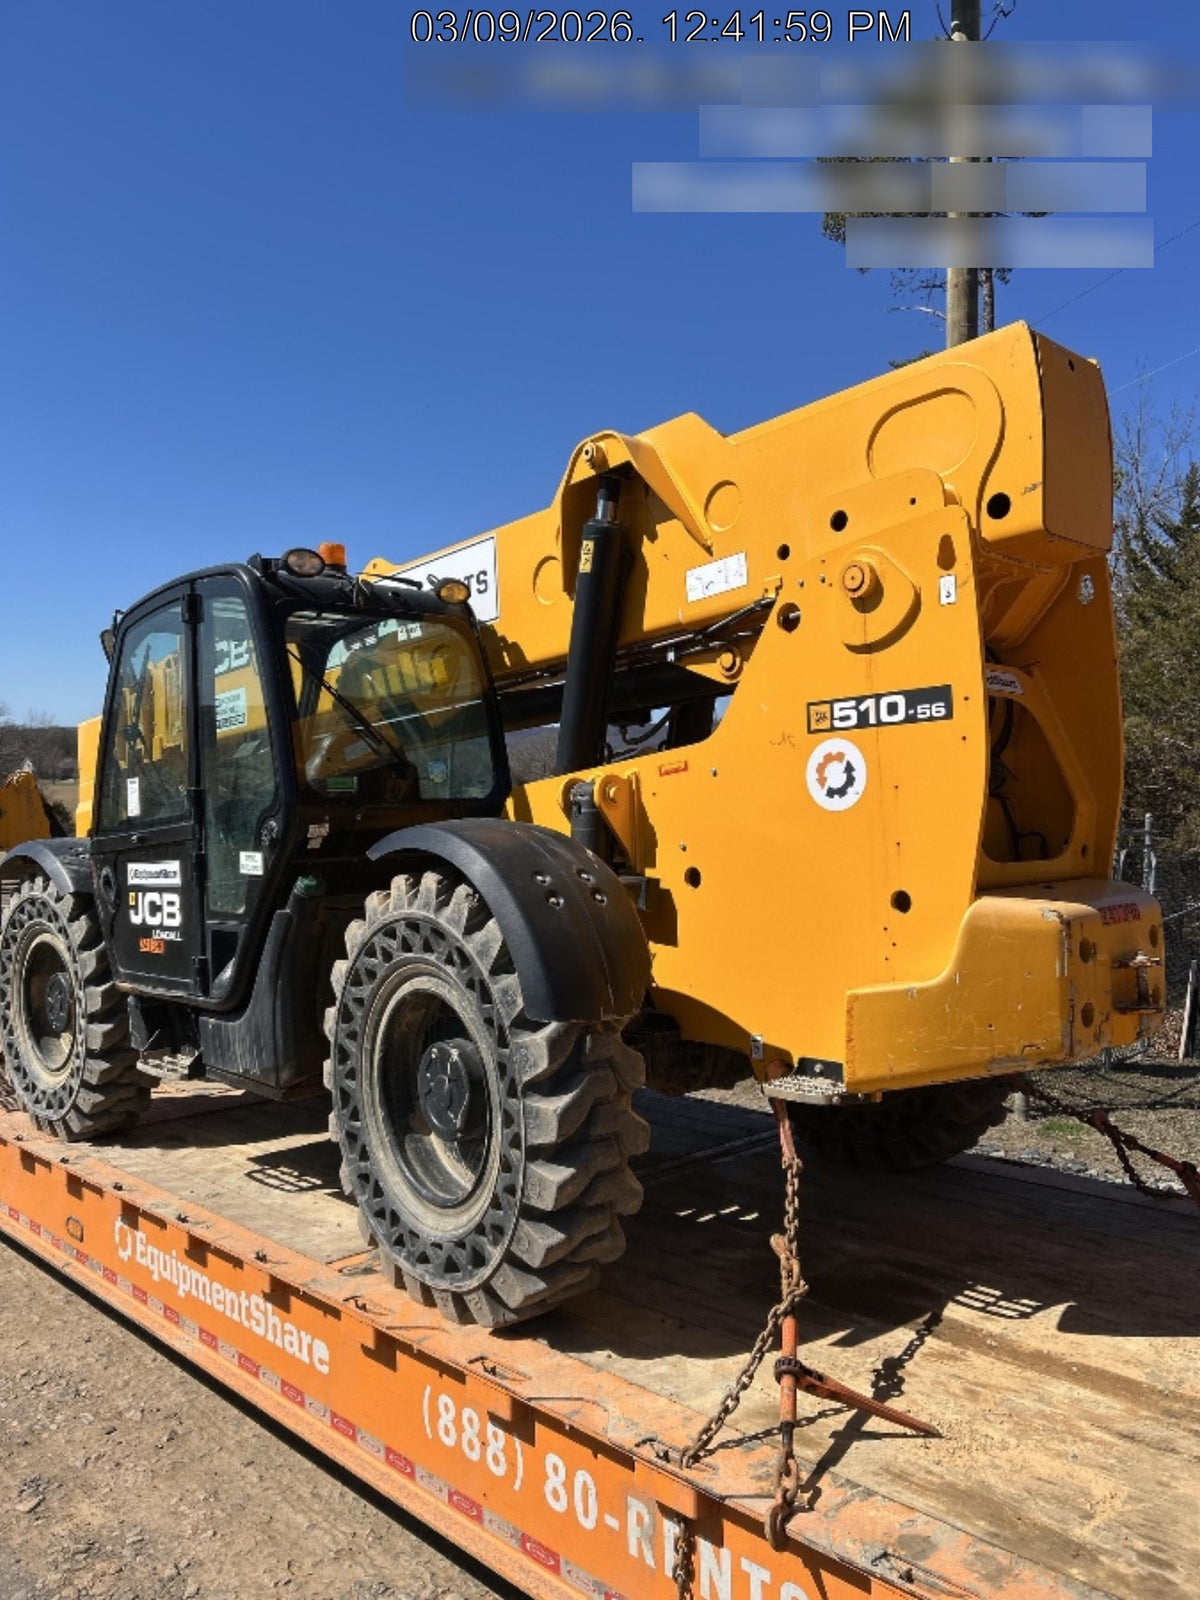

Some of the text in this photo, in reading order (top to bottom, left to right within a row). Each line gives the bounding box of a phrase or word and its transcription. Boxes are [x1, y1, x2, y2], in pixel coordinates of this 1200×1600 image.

[128, 891, 182, 927] JCB
[135, 1230, 330, 1376] EquipmentShare
[422, 1384, 524, 1492] (888)
